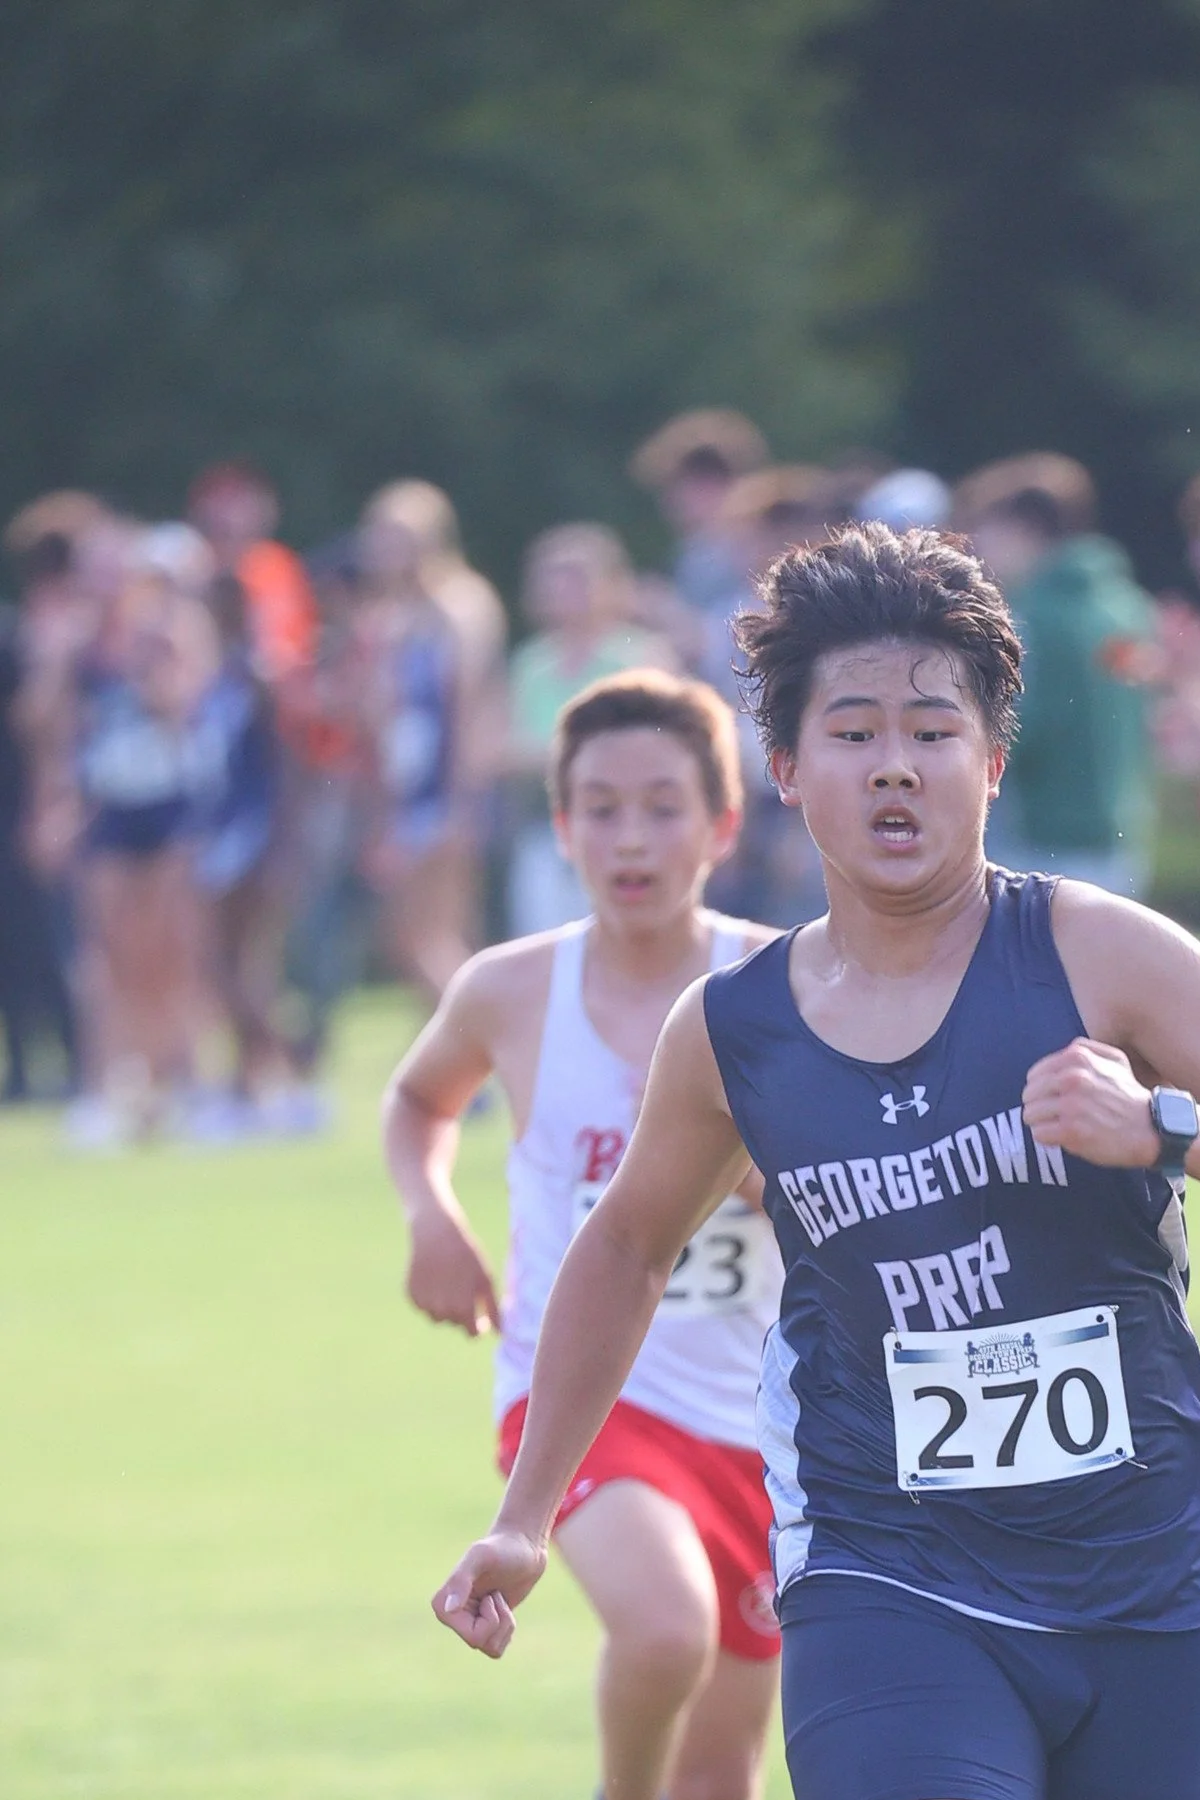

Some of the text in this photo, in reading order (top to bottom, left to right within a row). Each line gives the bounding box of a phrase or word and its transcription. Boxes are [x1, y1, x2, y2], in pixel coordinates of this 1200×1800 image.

[662, 1233, 744, 1299] 23
[975, 1354, 1032, 1373] CLASSIC
[912, 1367, 1109, 1471] 270
